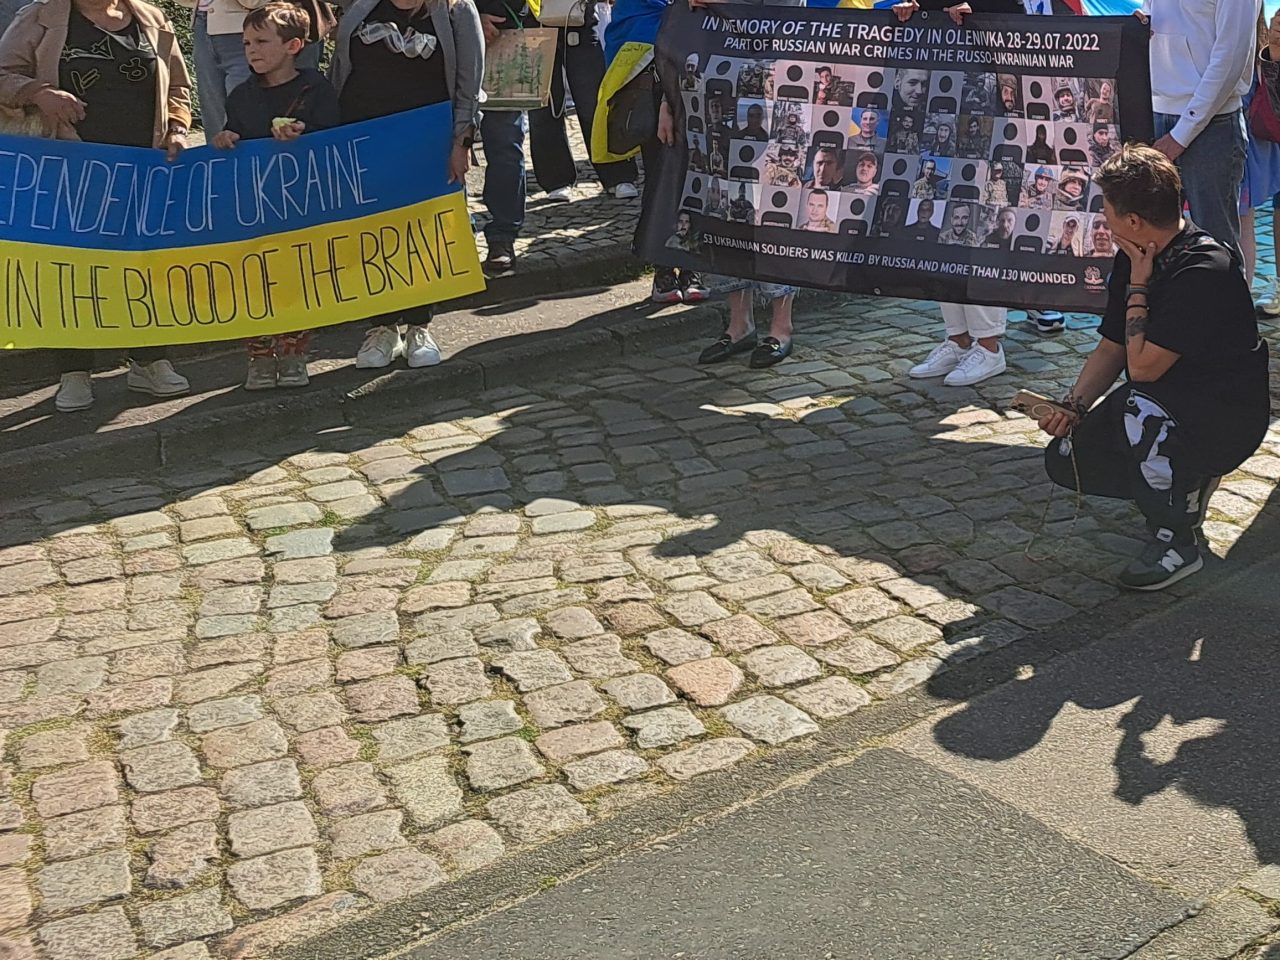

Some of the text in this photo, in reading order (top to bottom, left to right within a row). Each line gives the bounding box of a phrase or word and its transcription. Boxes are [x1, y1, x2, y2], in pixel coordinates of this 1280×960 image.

[702, 15, 1100, 52] IN MEMORY OF THE TRAGEDY IN OLENIVKA 28-29.07.2022
[723, 36, 1075, 69] PART OF RUSSIAN WAR CRIMES IN THE RUSSO-UKRAINIAN WAR
[185, 158, 226, 232] OF
[234, 136, 378, 227] UKRAINE
[6, 208, 470, 329] IN THE BLOOD OF THE BRAVE
[703, 233, 1076, 285] 53 UKRAINIAN SOLDIERS WAS KILLED BY RUSSIA AND MORE THAN 130 WOUNDED
